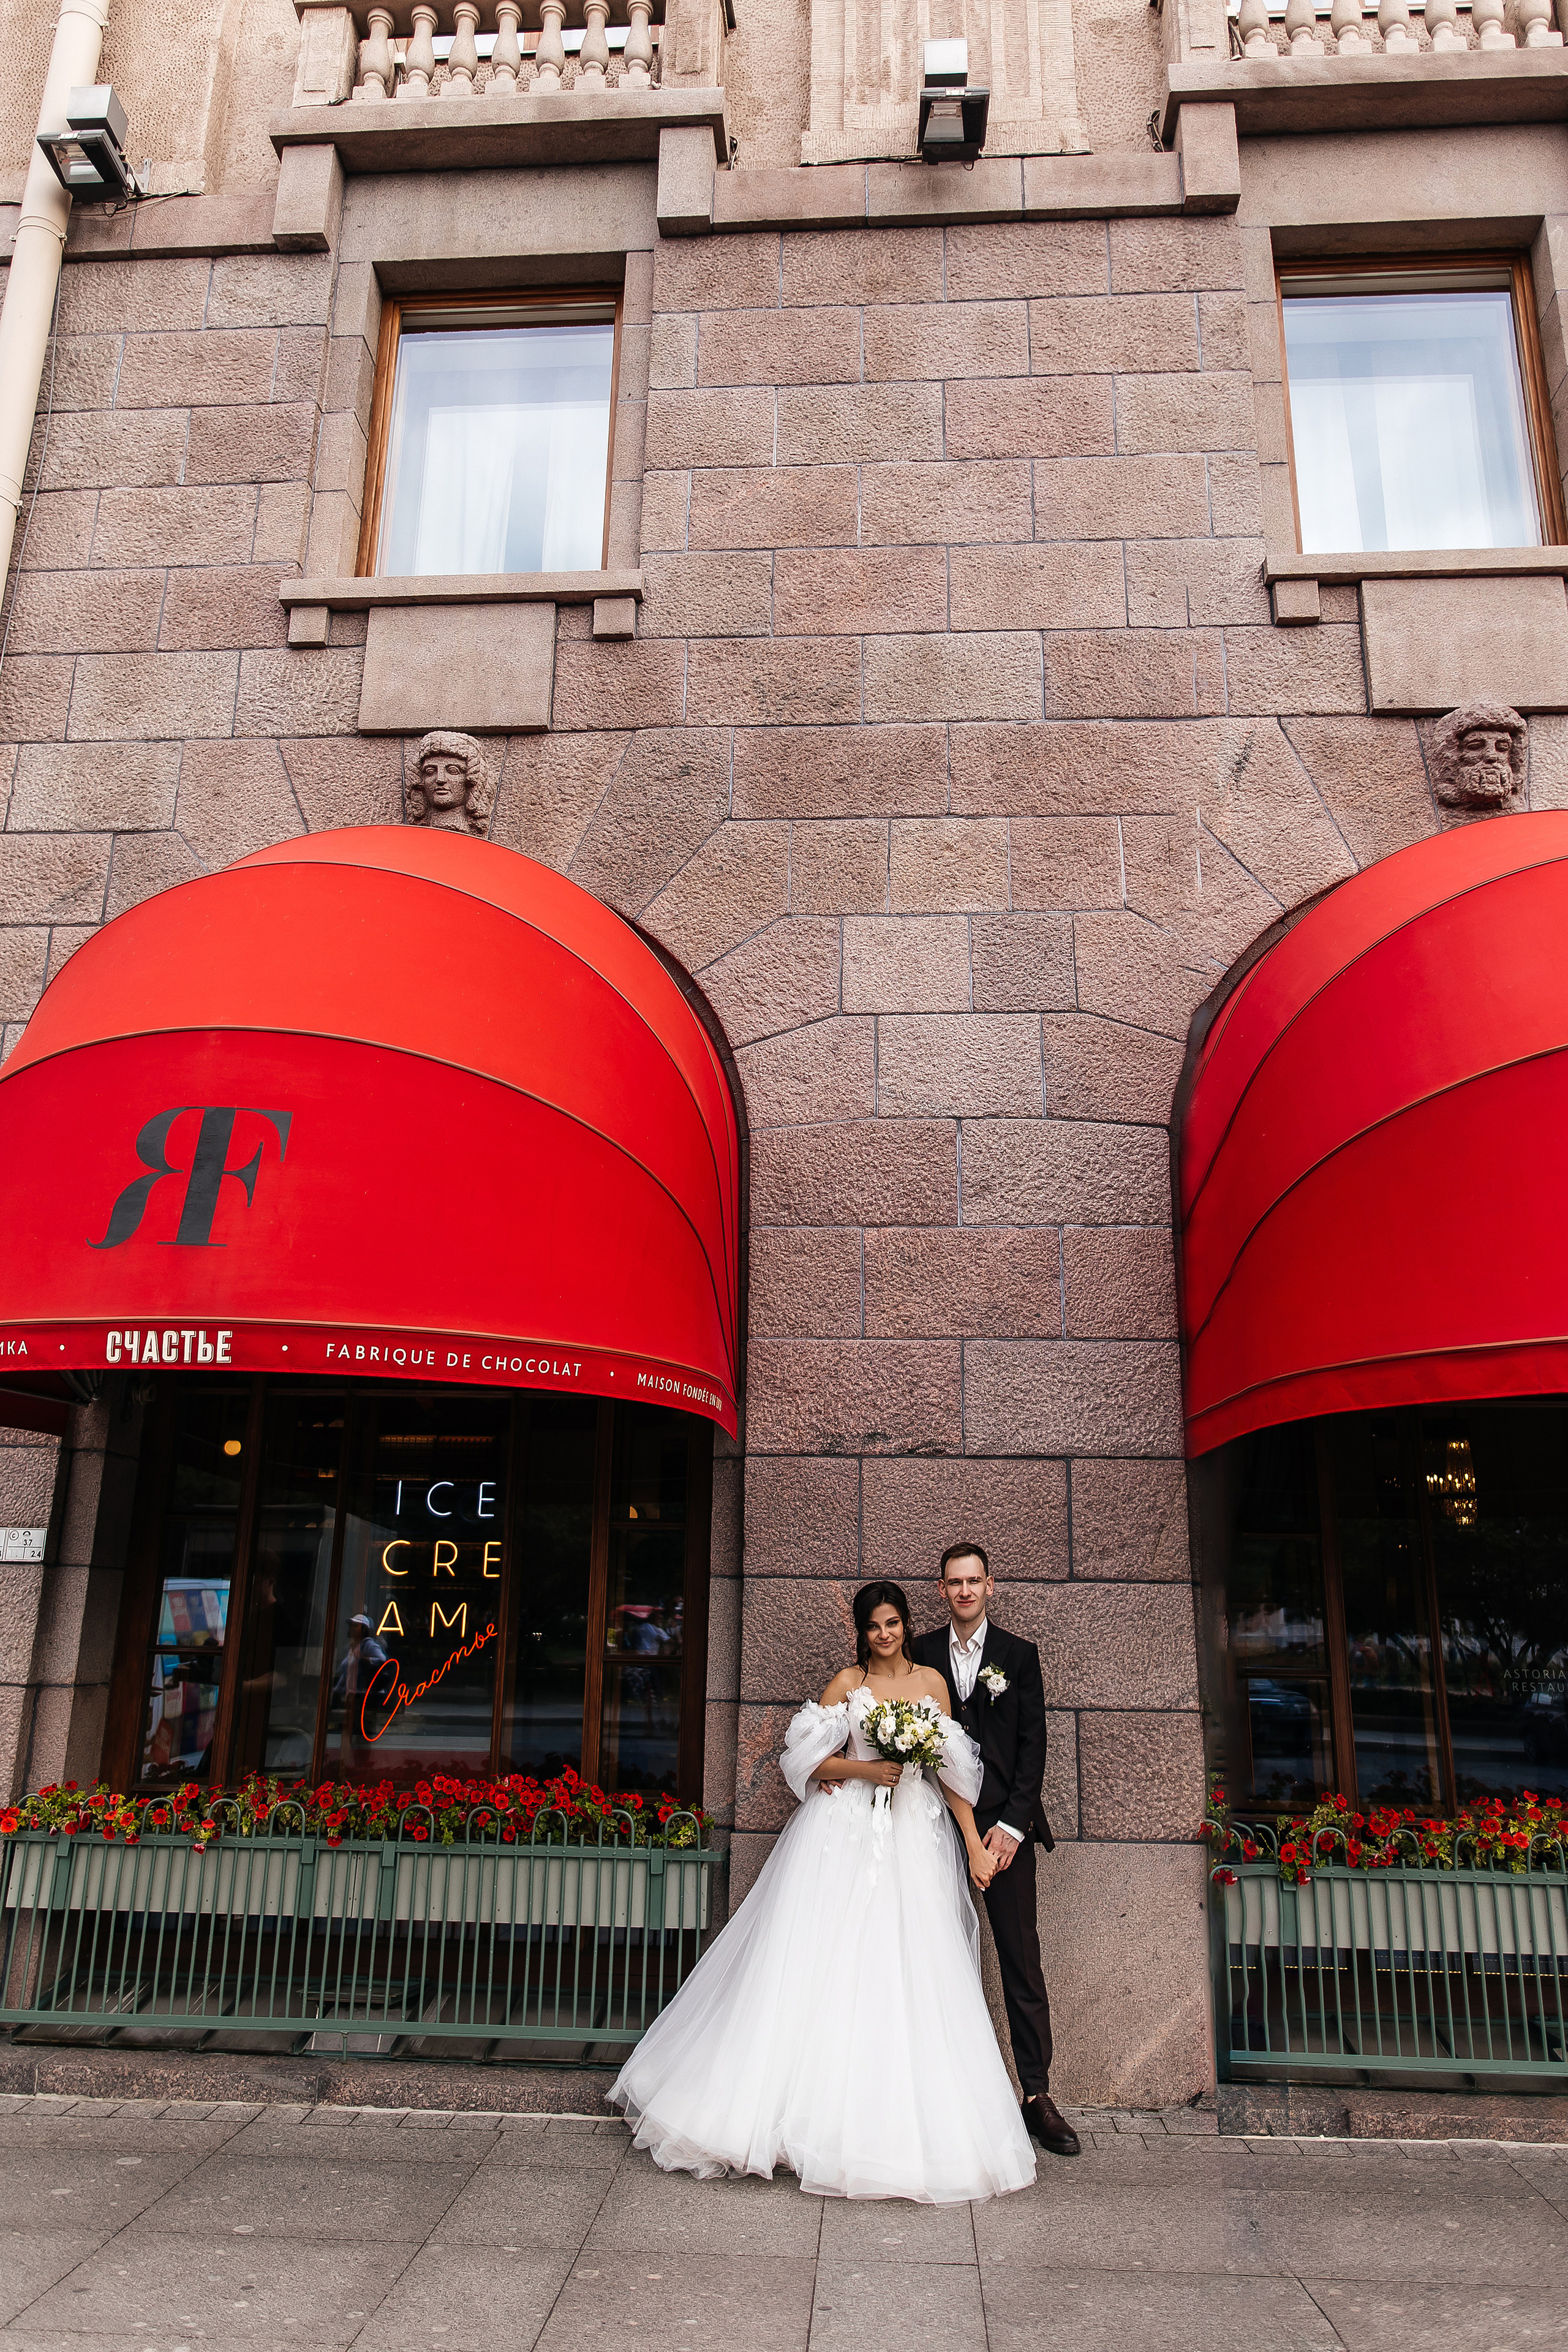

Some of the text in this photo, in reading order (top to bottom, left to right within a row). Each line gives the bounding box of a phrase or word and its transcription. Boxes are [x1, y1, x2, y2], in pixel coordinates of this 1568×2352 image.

[106, 1330, 233, 1363] СЧАСТЬЕ
[326, 1343, 582, 1377] FABRIQUE DE CHOCOLAT
[637, 1372, 680, 1394] MAISON
[682, 1383, 709, 1403] FONDÉE
[709, 1393, 717, 1406] EN
[396, 1479, 496, 1518] ICE
[31, 1550, 42, 1558] 2.4
[382, 1539, 502, 1578] CRE
[375, 1600, 468, 1638] AM
[1504, 1668, 1566, 1679] ASTORIA
[1512, 1682, 1568, 1692] RESTAU
